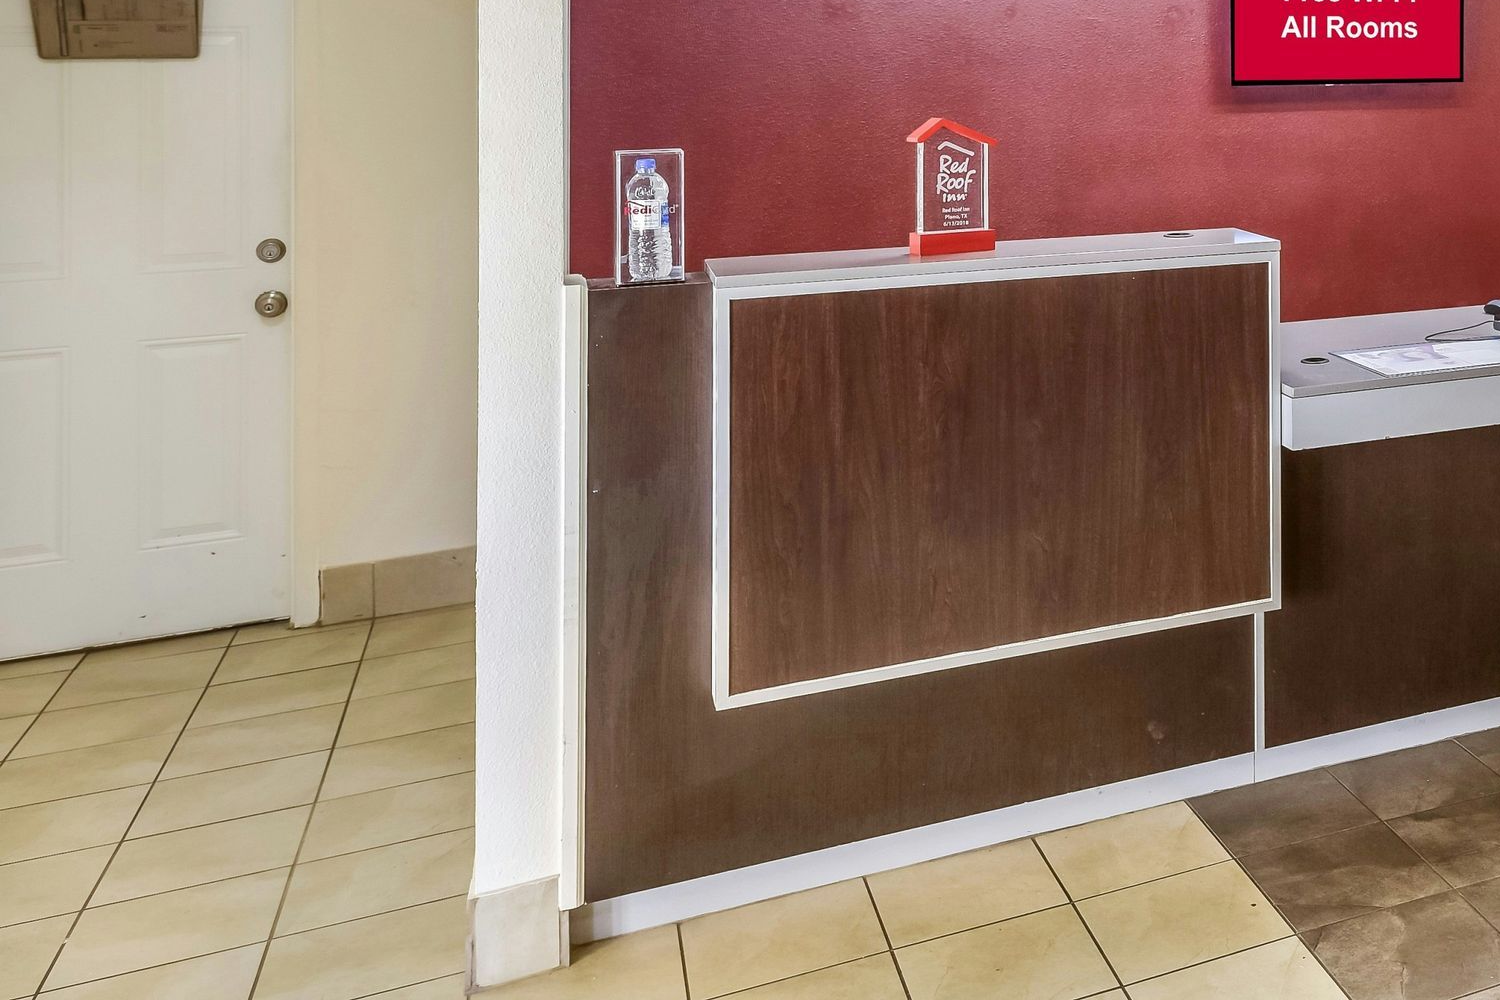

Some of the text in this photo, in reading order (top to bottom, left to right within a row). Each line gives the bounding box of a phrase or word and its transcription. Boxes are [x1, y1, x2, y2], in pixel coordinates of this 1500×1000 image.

[1280, 15, 1419, 39] All Rooms
[939, 154, 969, 174] Red
[936, 169, 976, 195] Roof
